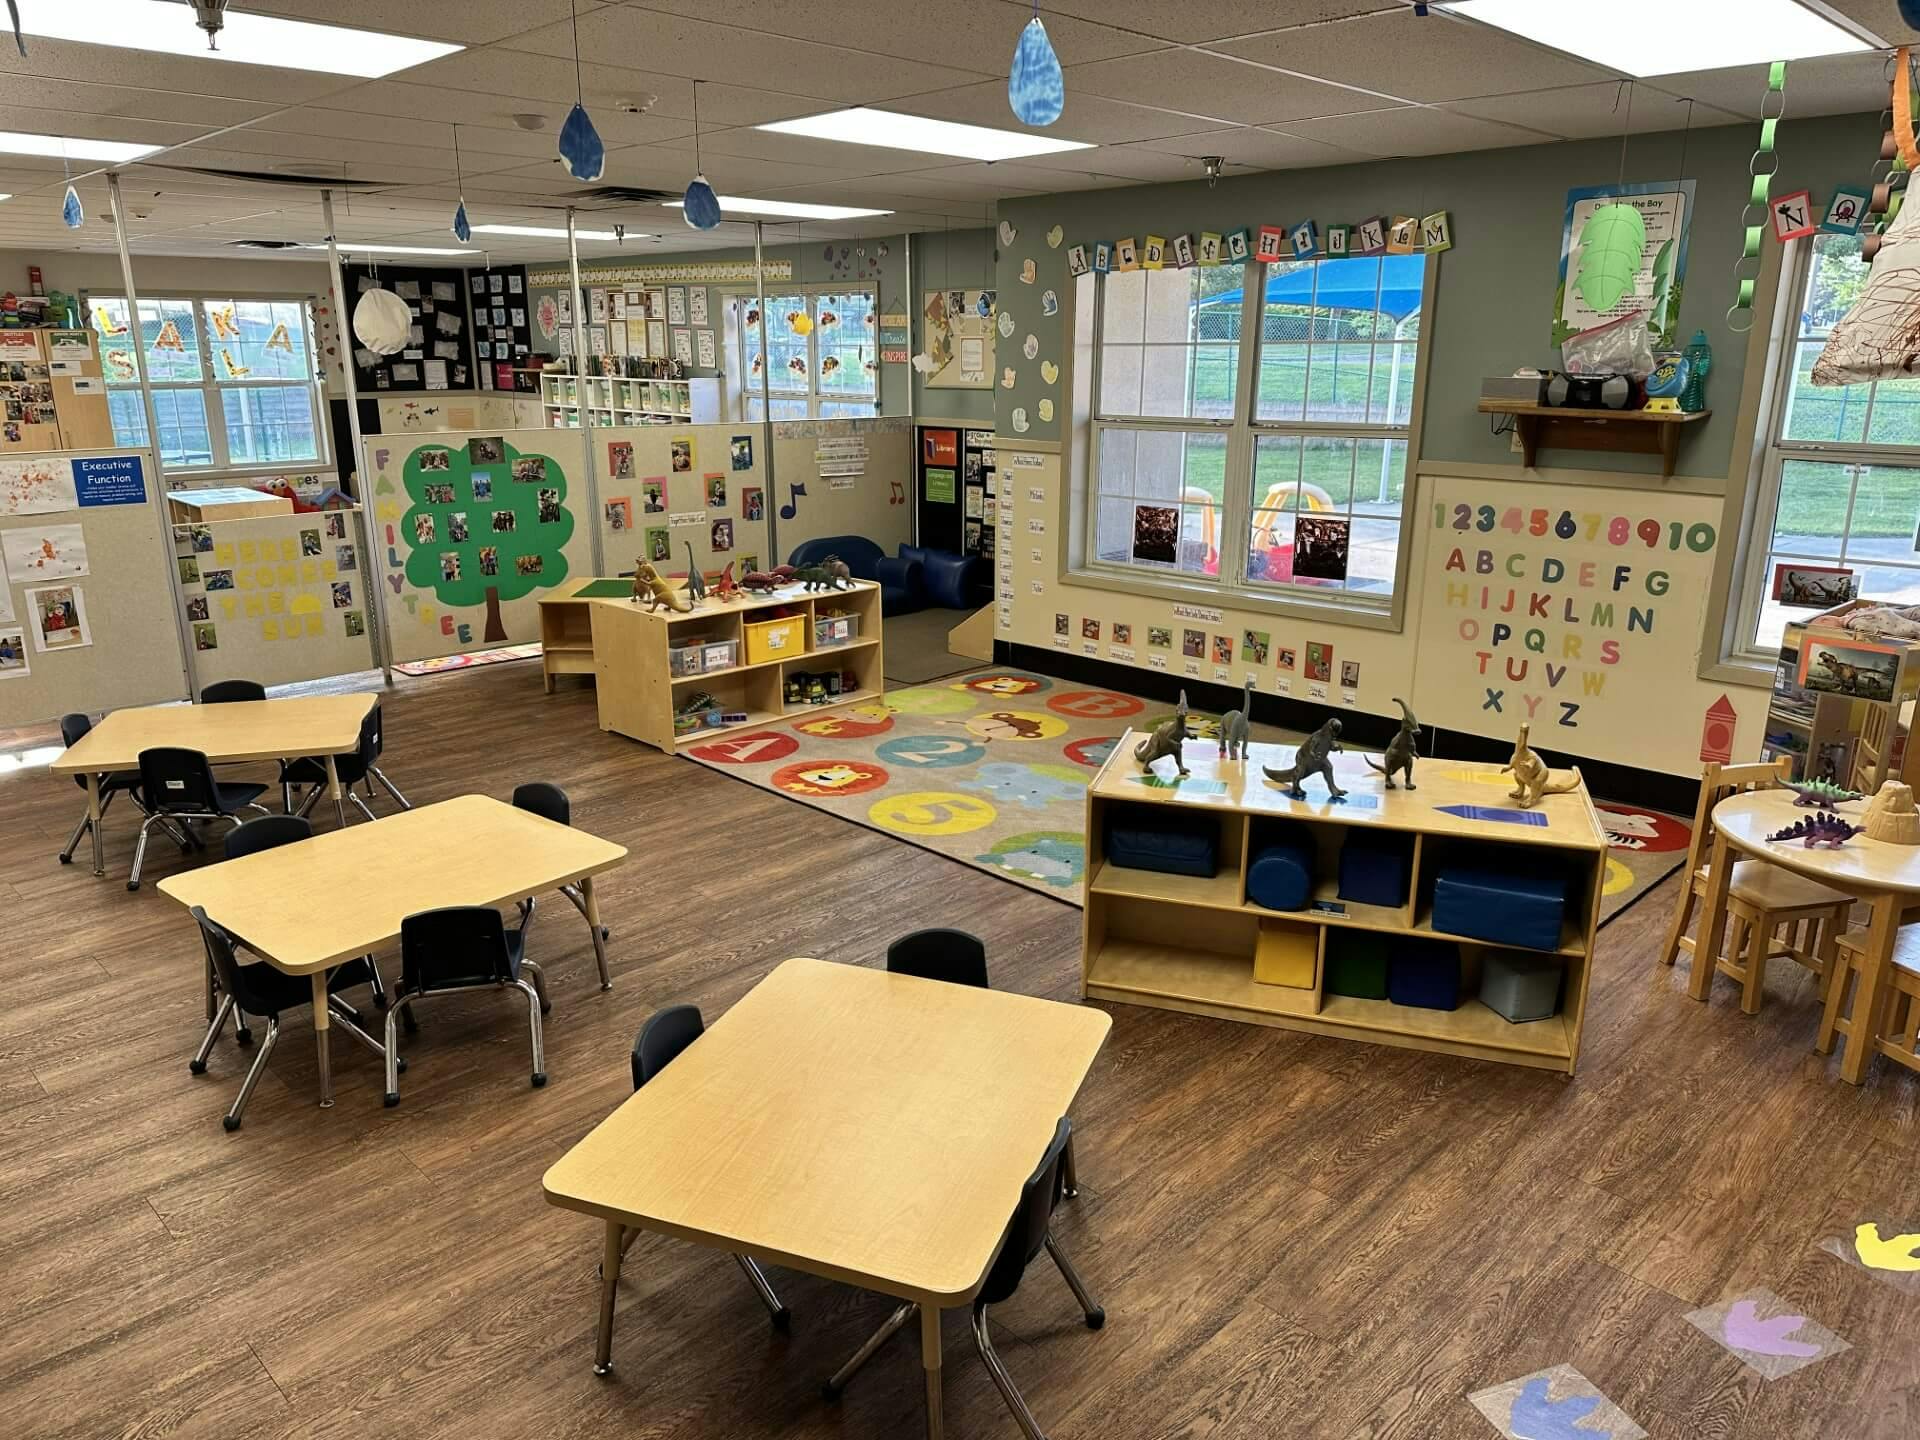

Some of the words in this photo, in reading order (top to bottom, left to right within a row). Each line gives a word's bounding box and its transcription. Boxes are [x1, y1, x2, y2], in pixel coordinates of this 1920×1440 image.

[1632, 200, 1645, 208] the
[1647, 200, 1663, 208] Bay
[1072, 248, 1086, 272] A
[1149, 245, 1161, 262] D
[1263, 235, 1276, 253] H
[1365, 228, 1382, 247] K
[1426, 223, 1445, 246] M
[1779, 204, 1804, 231] N
[82, 460, 133, 471] Executive
[87, 474, 131, 484] Function
[1435, 503, 1446, 528] 1
[1452, 503, 1471, 530] 2
[1476, 505, 1495, 532] 3
[1500, 507, 1524, 534] 4
[1529, 508, 1548, 536] 5
[1555, 510, 1576, 539] 6
[1582, 514, 1602, 541] 7
[1607, 516, 1630, 546] 8
[1637, 519, 1660, 548] 9
[1669, 522, 1716, 552] 10
[1445, 548, 1466, 572] A
[1476, 550, 1494, 574] B
[1506, 554, 1526, 577] C
[1542, 558, 1564, 583] D
[1578, 562, 1596, 587] E
[1612, 566, 1631, 591] F
[1645, 570, 1670, 596] G
[1447, 583, 1468, 606] H
[1480, 586, 1489, 610] I
[1500, 589, 1515, 612] J
[1529, 592, 1551, 618] K
[1564, 598, 1580, 622] L
[1590, 602, 1614, 628] M
[1628, 606, 1654, 634] N
[1459, 618, 1480, 640] O
[1492, 623, 1511, 646] P
[1524, 628, 1545, 653] Q
[1562, 634, 1582, 658] R
[1600, 640, 1620, 664] S
[1476, 651, 1492, 674] T
[1506, 656, 1528, 682] U
[1546, 662, 1566, 687] V
[1582, 672, 1606, 696] W
[1483, 688, 1504, 712] X
[1523, 694, 1542, 718] Y
[1559, 702, 1580, 727] Z
[704, 738, 780, 761] A
[891, 741, 967, 763] 2
